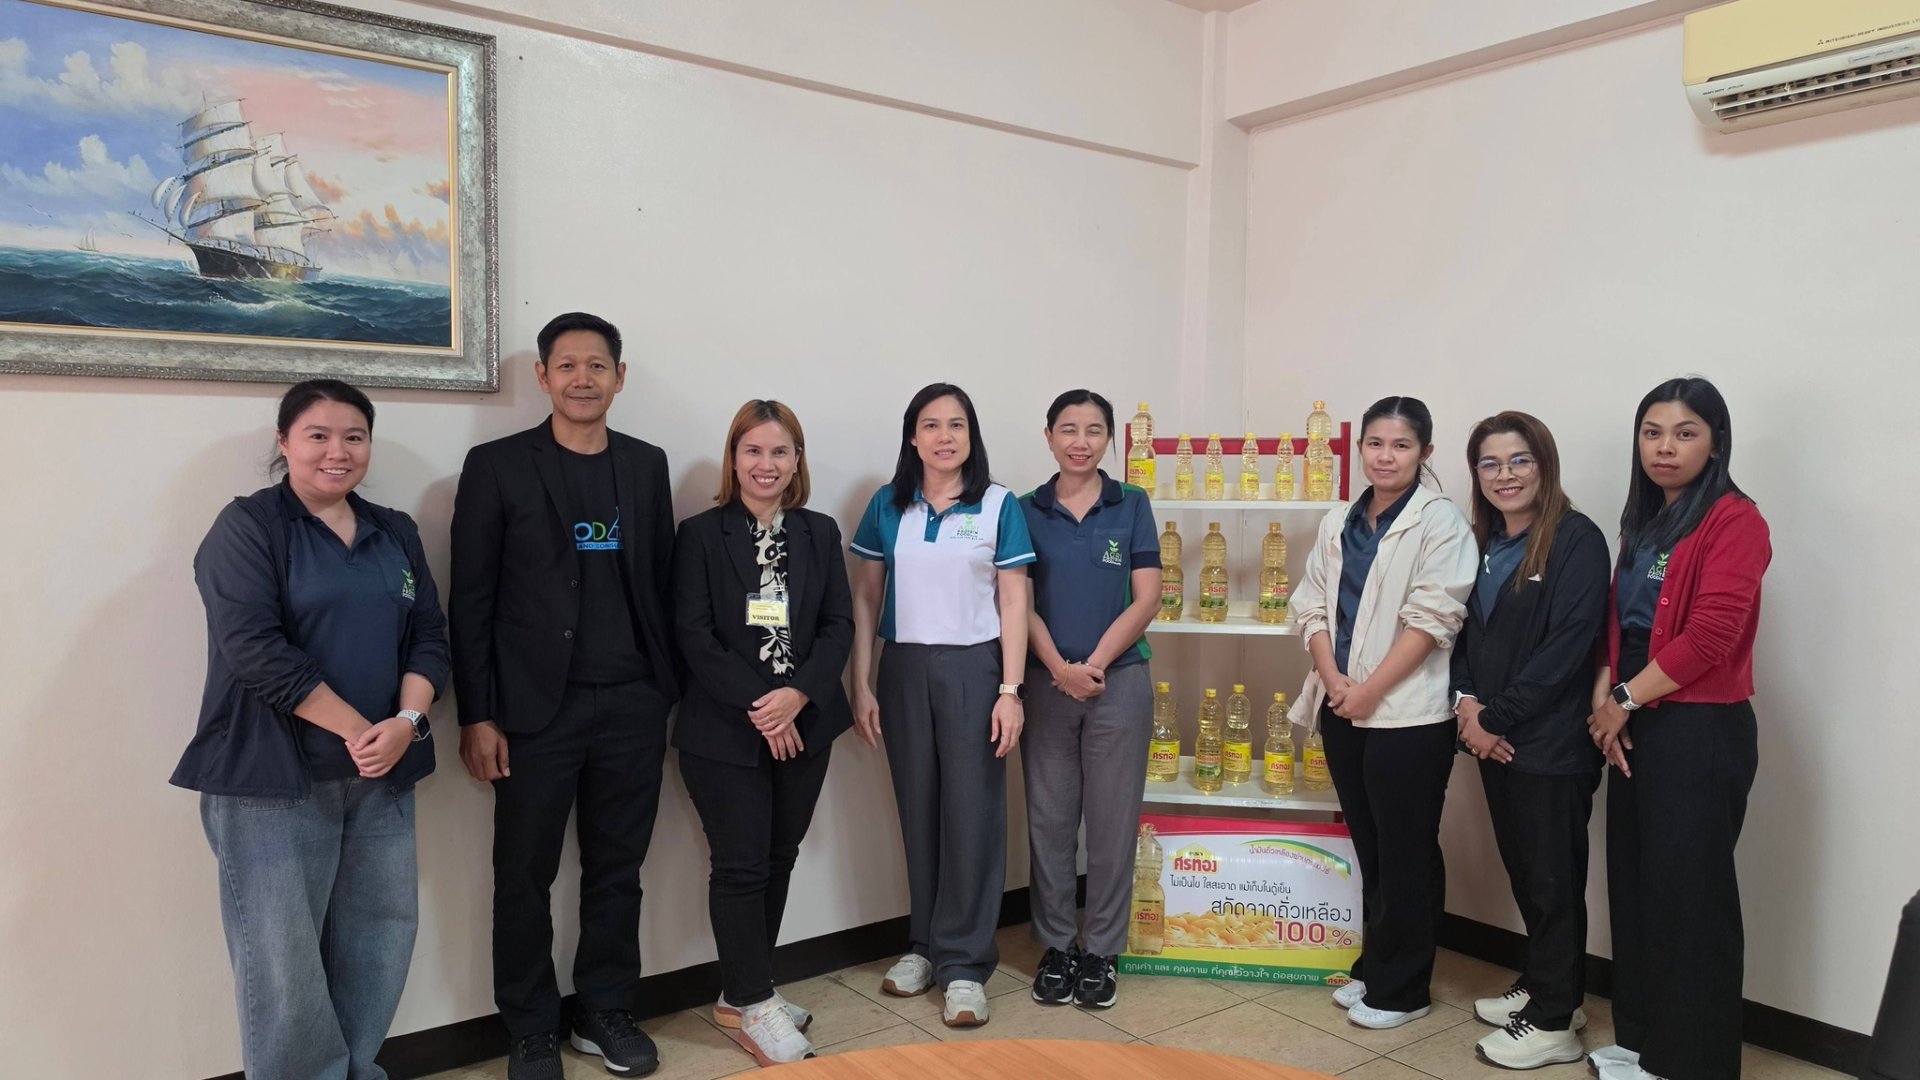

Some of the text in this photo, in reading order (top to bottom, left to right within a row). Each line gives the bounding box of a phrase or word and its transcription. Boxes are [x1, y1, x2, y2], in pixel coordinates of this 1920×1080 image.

[1174, 856, 1217, 872] ศรทอง
[1170, 874, 1291, 896] ไม่เป็นไข ใสสะอาด แม้เก็บในตู้เย็น
[1211, 896, 1352, 922] สกัดจากถั่วเหลือง
[1125, 962, 1152, 972] คุณค่า
[1154, 964, 1170, 972] และ
[1173, 965, 1208, 975] คุณภาพ
[1272, 970, 1320, 982] ต่อสุขภาพ
